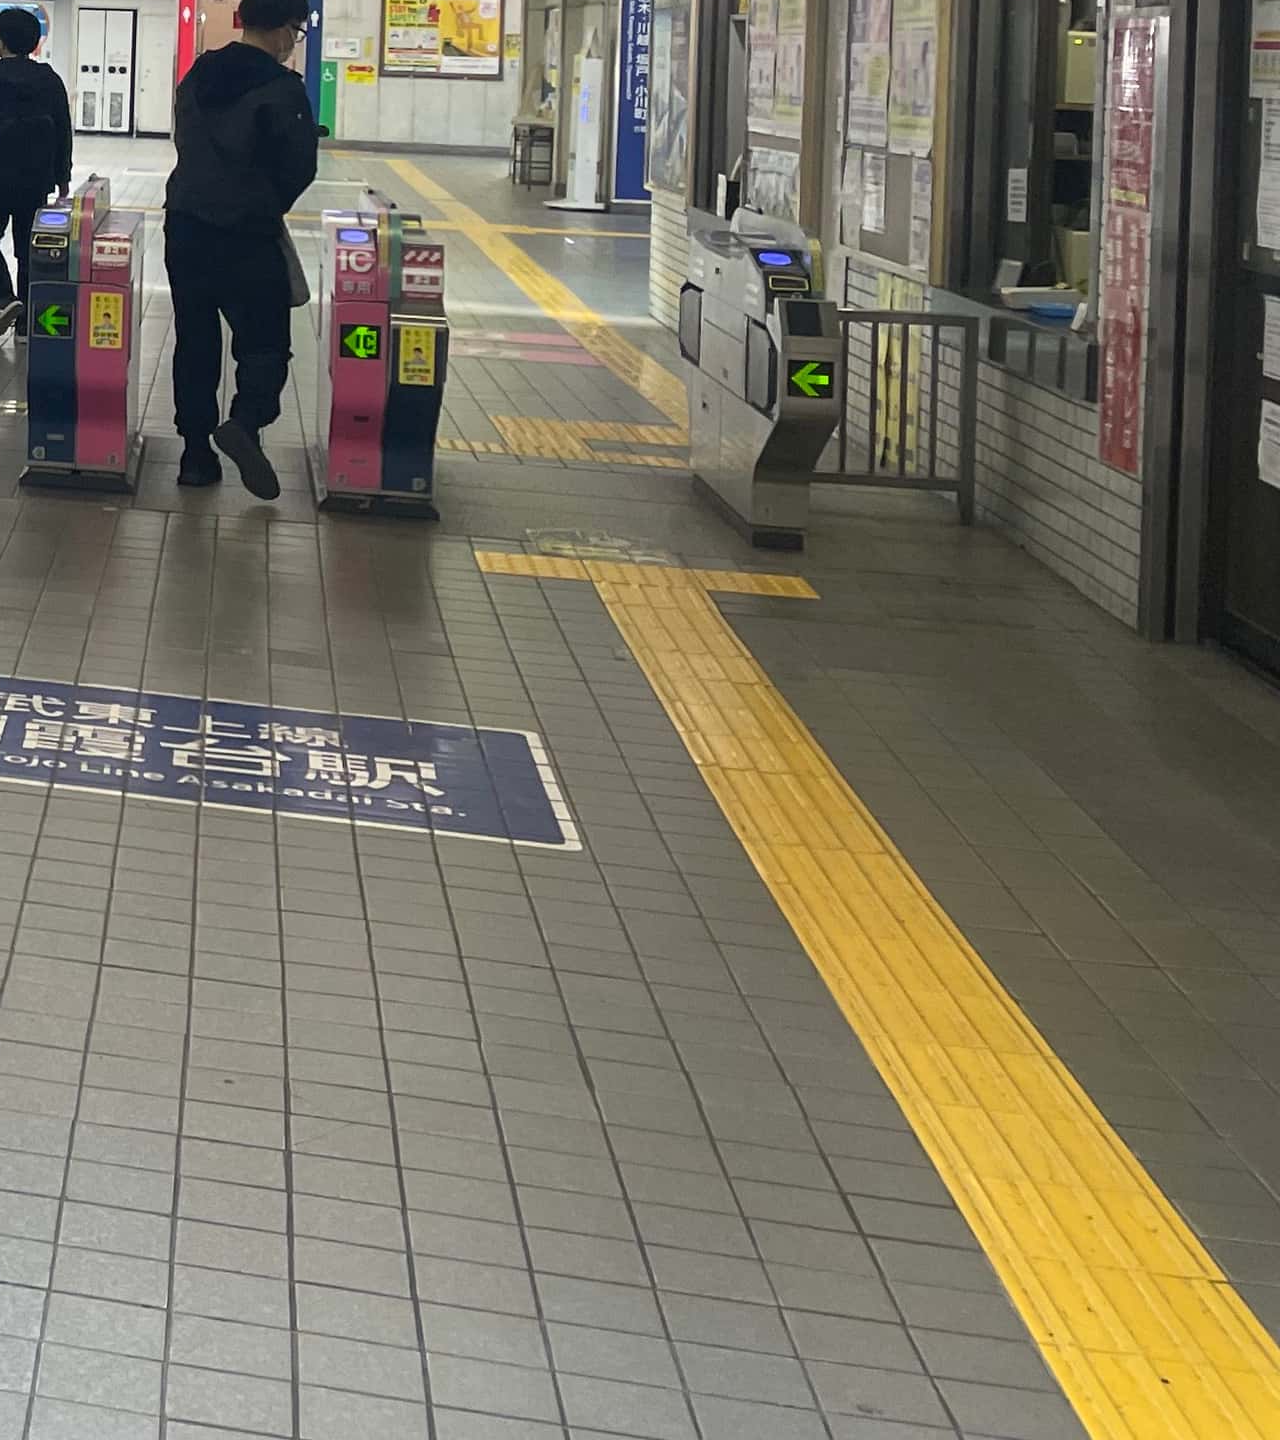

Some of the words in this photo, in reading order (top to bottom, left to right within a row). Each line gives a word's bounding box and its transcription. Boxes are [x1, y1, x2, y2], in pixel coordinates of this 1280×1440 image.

[337, 249, 374, 273] IC
[342, 280, 372, 295] 専用
[356, 334, 375, 352] IC
[79, 760, 166, 782] Line
[176, 773, 373, 806] Asakadai
[386, 798, 467, 817] Sta.
